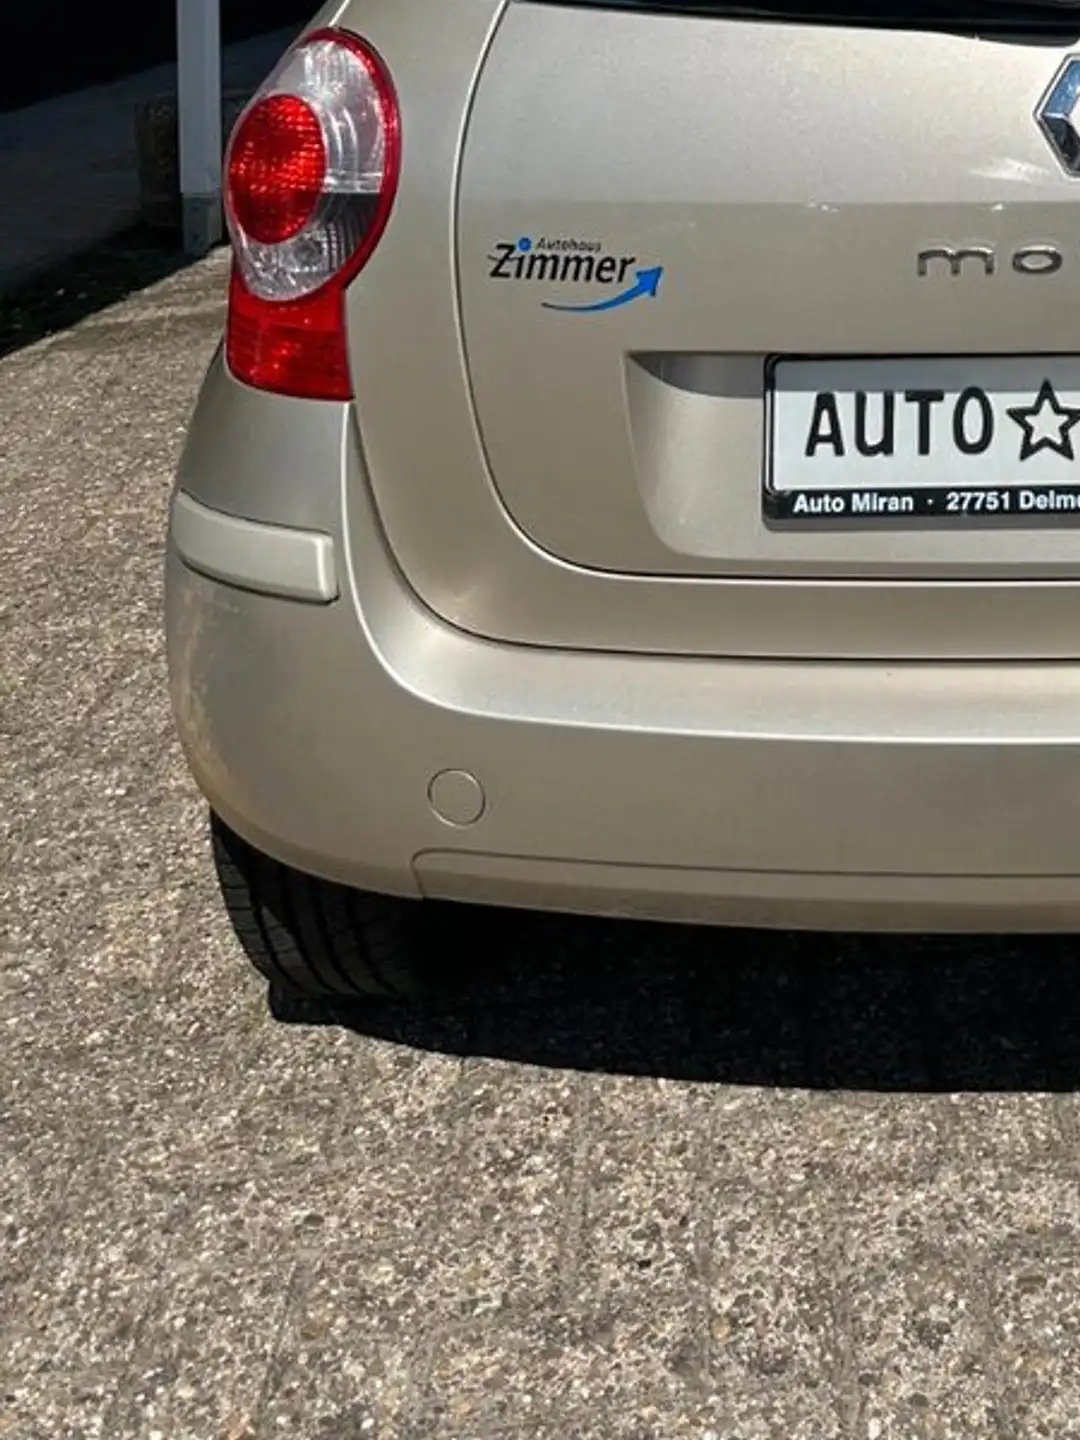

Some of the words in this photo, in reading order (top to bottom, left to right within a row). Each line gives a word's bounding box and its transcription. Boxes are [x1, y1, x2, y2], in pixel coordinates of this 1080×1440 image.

[487, 242, 636, 284] Zimmer
[805, 386, 994, 457] AUTO
[793, 493, 845, 513] Auto
[851, 492, 914, 513] Miran
[945, 490, 1010, 511] 27751
